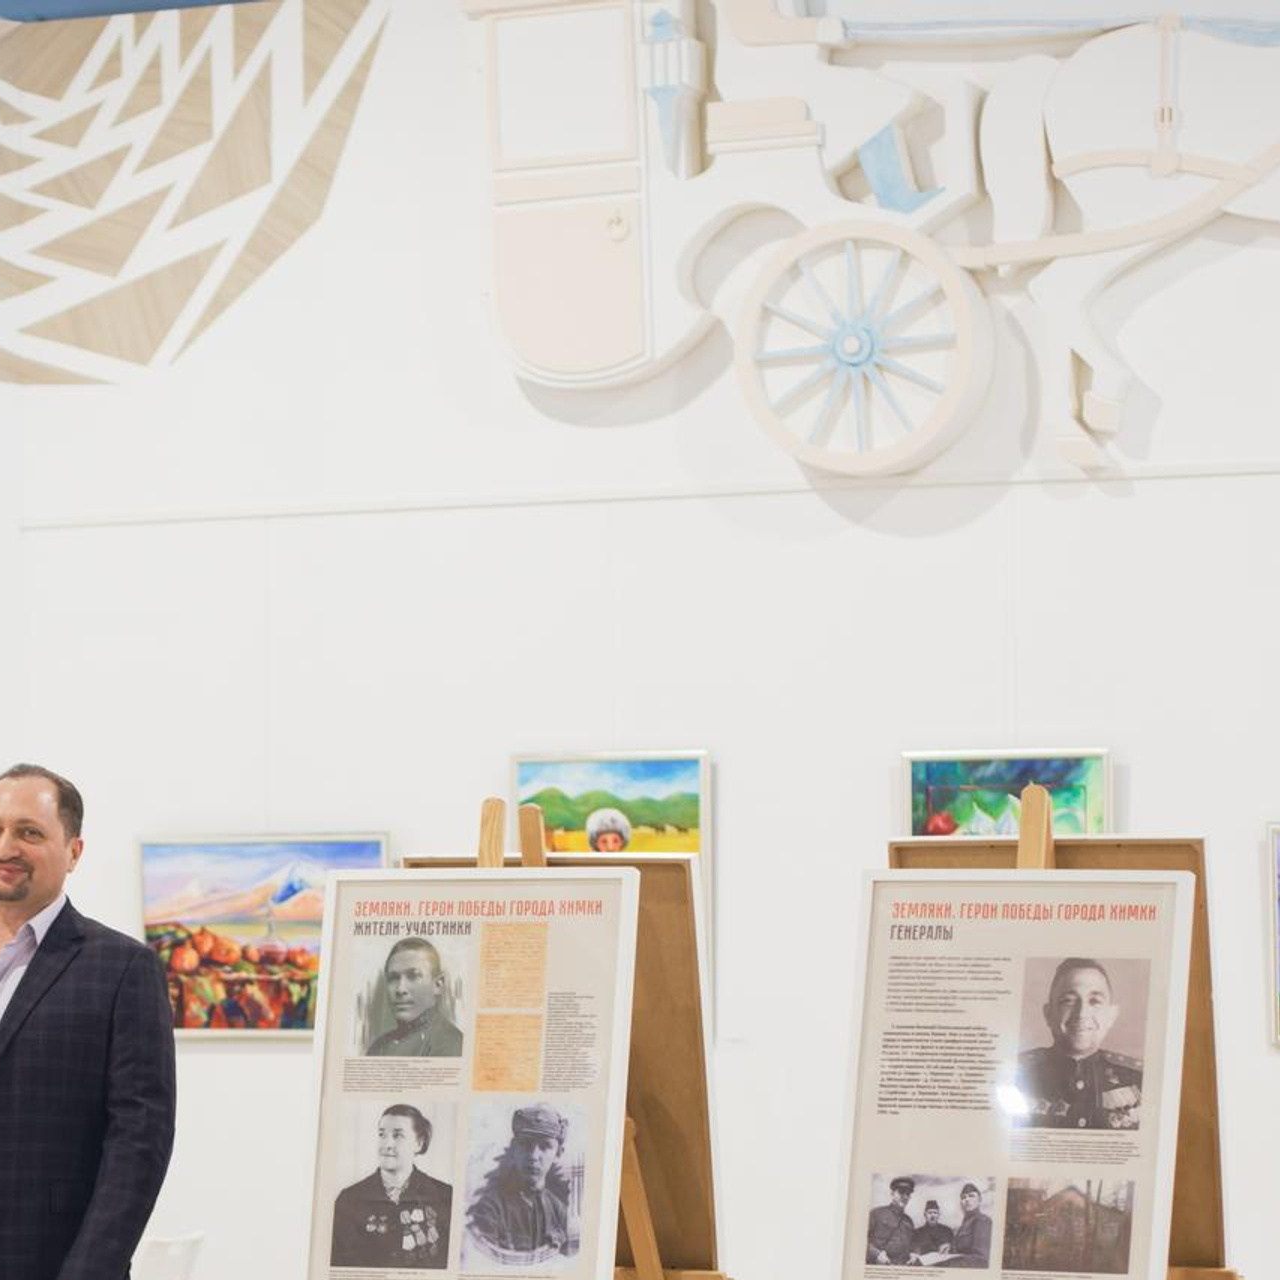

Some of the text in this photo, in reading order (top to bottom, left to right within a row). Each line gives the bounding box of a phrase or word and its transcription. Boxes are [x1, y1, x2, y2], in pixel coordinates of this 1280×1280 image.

[354, 900, 603, 917] ЗЕМЛЯКИ. ГЕРОИ ПОБЕДЫ ГОРОДА ХИМКИ
[892, 902, 1157, 921] ЗЕМЛЯКИ. ГЕРОИ ПОБЕДЫ ГОРОДА ХИМКИ
[353, 921, 472, 936] ЖИТЕЛИ-УЧАСТНИКИ
[889, 924, 954, 941] ГЕНЕРАЛЫ
